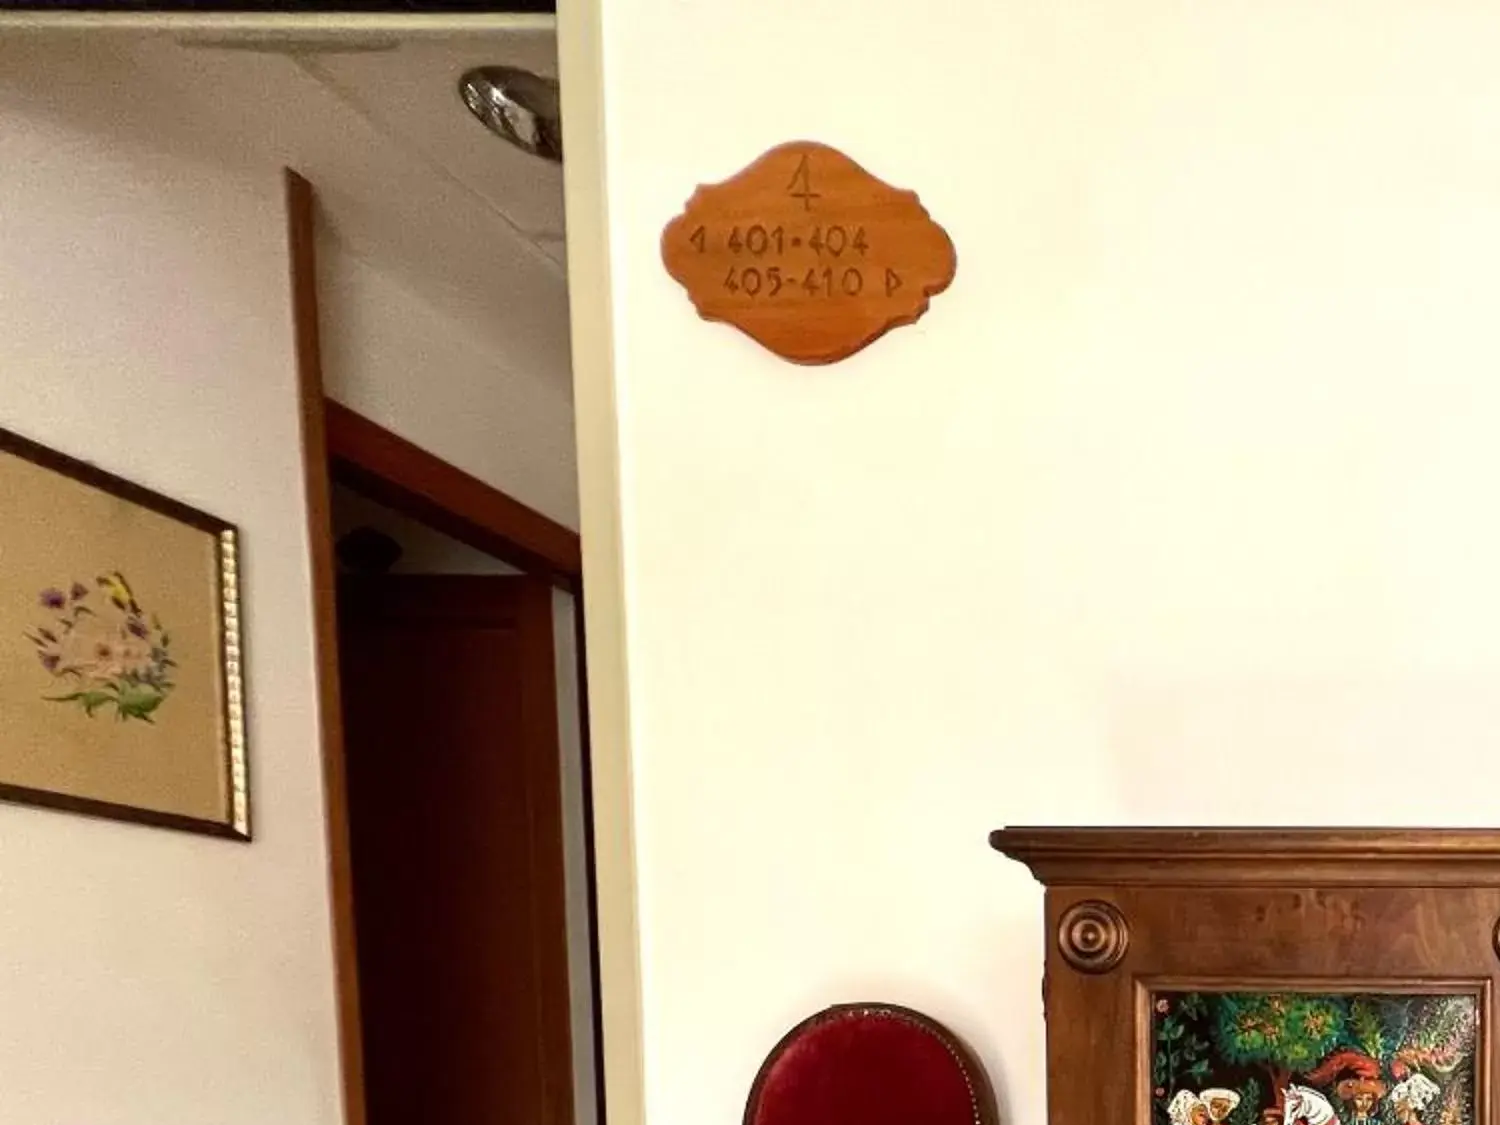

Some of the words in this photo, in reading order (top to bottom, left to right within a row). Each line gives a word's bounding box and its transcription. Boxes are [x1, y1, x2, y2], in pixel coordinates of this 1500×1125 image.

[786, 153, 821, 212] 4
[728, 224, 869, 258] 401-404
[723, 265, 863, 297] 405-410
